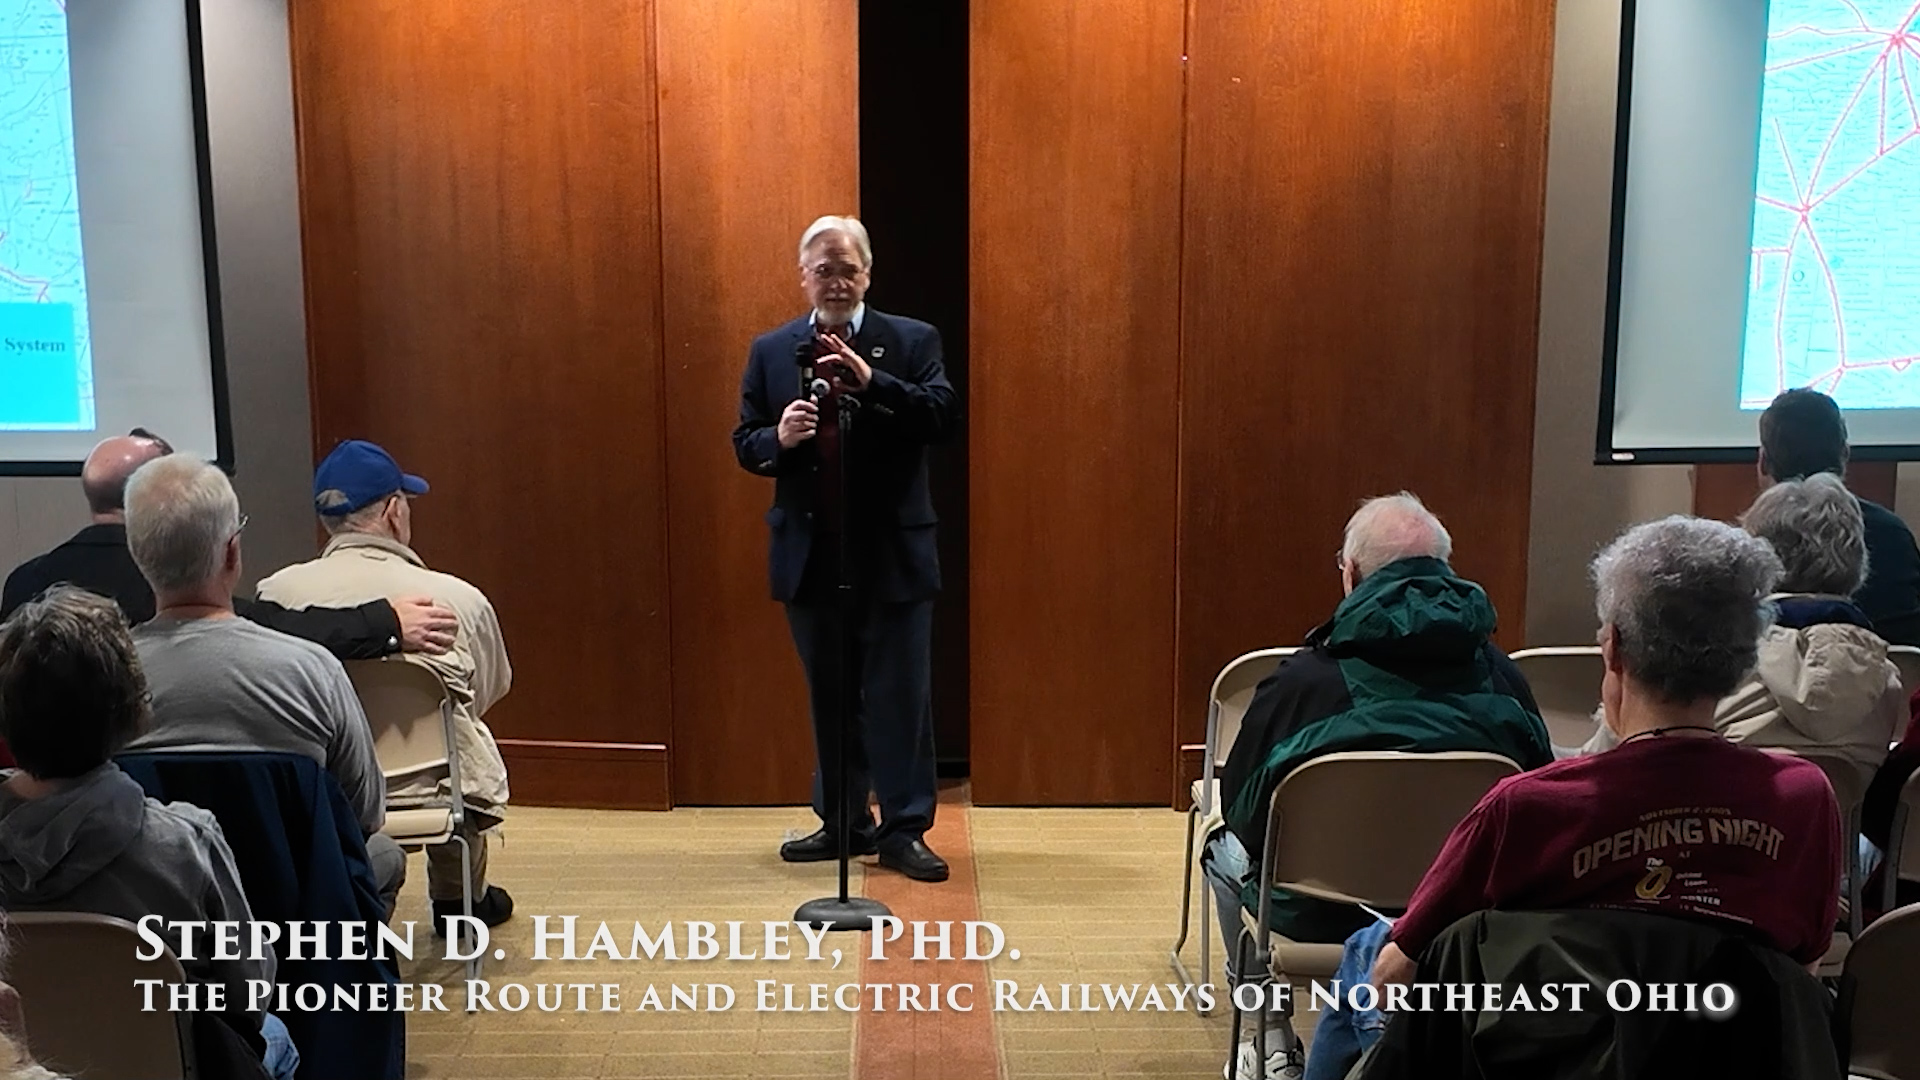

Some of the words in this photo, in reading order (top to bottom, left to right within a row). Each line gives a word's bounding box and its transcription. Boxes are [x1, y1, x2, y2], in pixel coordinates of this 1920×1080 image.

[5, 337, 65, 356] System
[1573, 818, 1704, 879] OPENING
[1708, 818, 1785, 861] NIGHT
